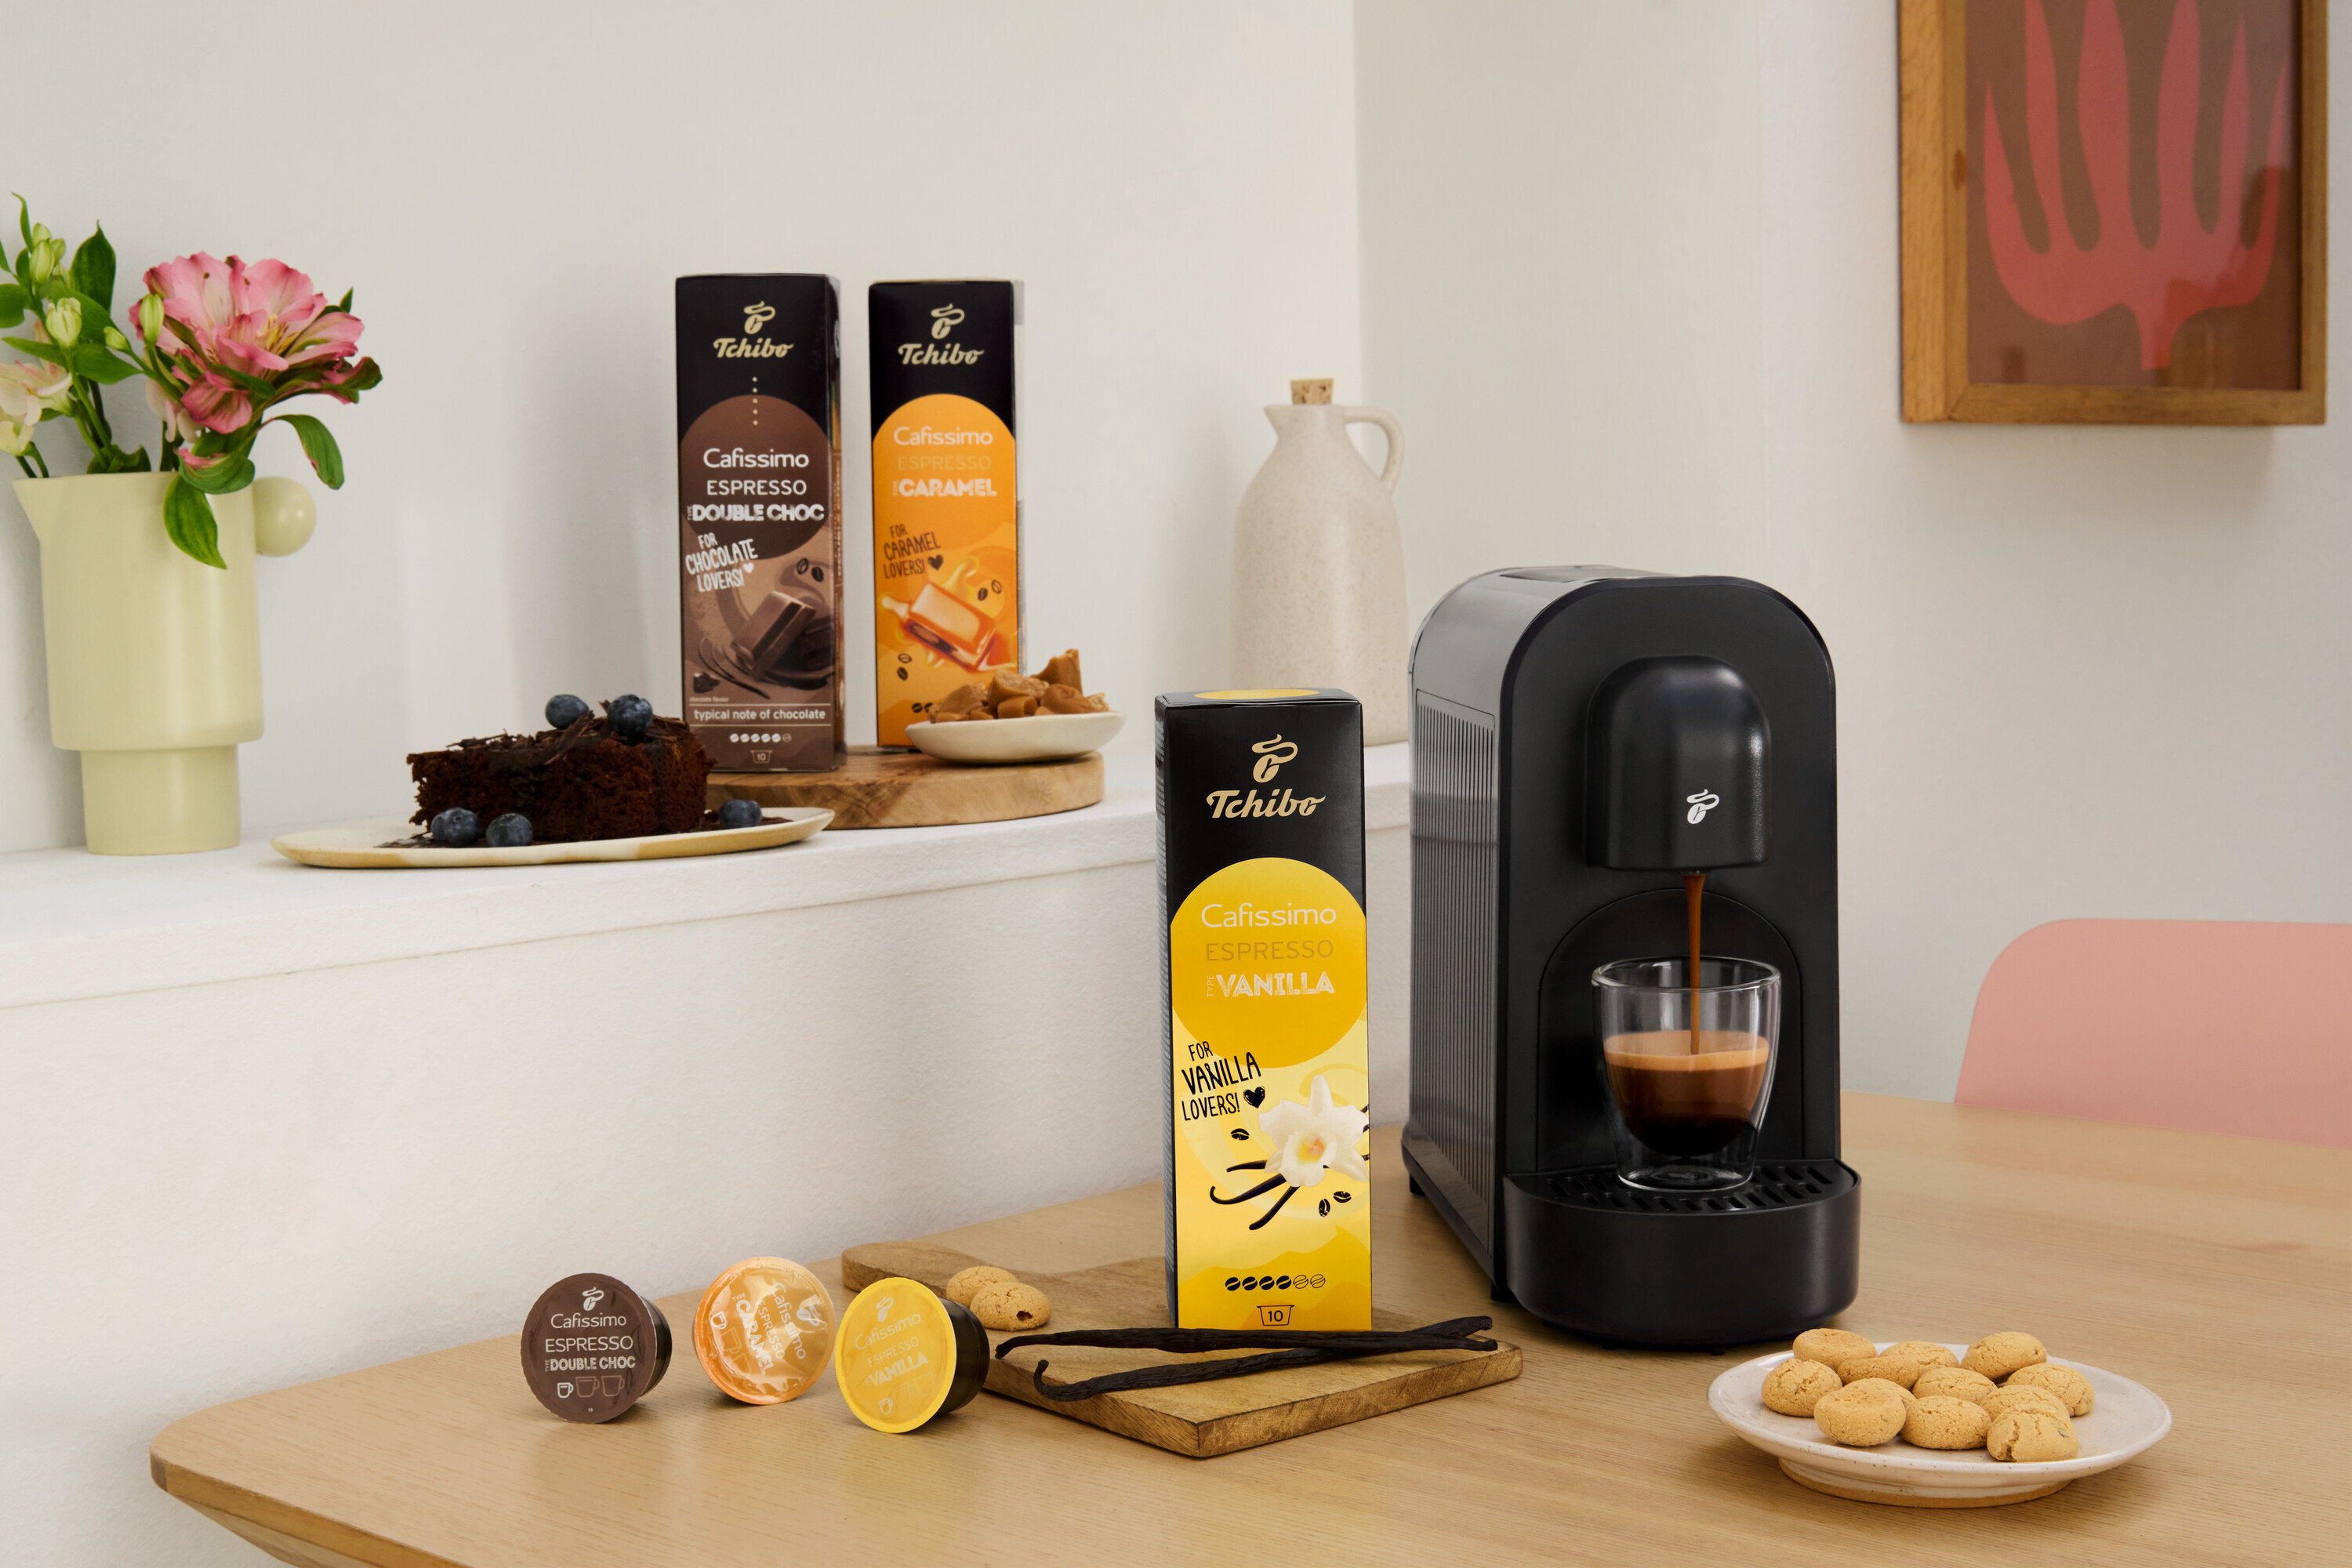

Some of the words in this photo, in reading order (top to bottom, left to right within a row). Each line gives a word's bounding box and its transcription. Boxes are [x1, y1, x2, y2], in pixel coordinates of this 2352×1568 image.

[713, 337, 794, 358] Tchibo
[898, 343, 984, 365] Tchibo
[894, 426, 993, 445] Cafissimo
[703, 448, 810, 468] Cafissimo
[897, 456, 992, 470] ESPRESSO
[707, 480, 807, 495] ESPRESSO
[898, 478, 997, 497] CARAMEL
[692, 504, 764, 521] DOUBLE
[767, 504, 825, 521] CHOC
[698, 532, 718, 549] FOR
[890, 524, 908, 539] FOR
[884, 531, 941, 561] CARAMEL
[685, 539, 758, 575] CHOCOLATE
[884, 558, 926, 579] LOVERS!
[697, 569, 745, 592] LOVERS!
[694, 709, 730, 720] typical
[733, 710, 757, 720] note
[760, 709, 770, 719] of
[773, 709, 826, 720] chocolate
[1206, 789, 1326, 818] Tchibo
[1201, 902, 1337, 927] Cafissimo
[1206, 940, 1333, 961] ESPRESSO
[1216, 971, 1334, 996] VANILLA
[1188, 1041, 1214, 1062] FOR
[1181, 1051, 1261, 1094] VANILLA
[1181, 1092, 1240, 1121] LOVERS!
[550, 1312, 626, 1329] Cafissimo
[771, 1283, 806, 1359] Cafissimo
[1267, 1310, 1283, 1323] 10
[735, 1299, 775, 1376] CARAMEL
[758, 1300, 786, 1359] ESPRESSO
[855, 1313, 921, 1350] Cafissimo
[545, 1335, 633, 1352] ESPRESSO
[867, 1336, 920, 1367] ESPRESSO
[550, 1357, 597, 1371] DOUBLE
[599, 1356, 636, 1370] CHOC
[869, 1351, 929, 1386] VANILLA
